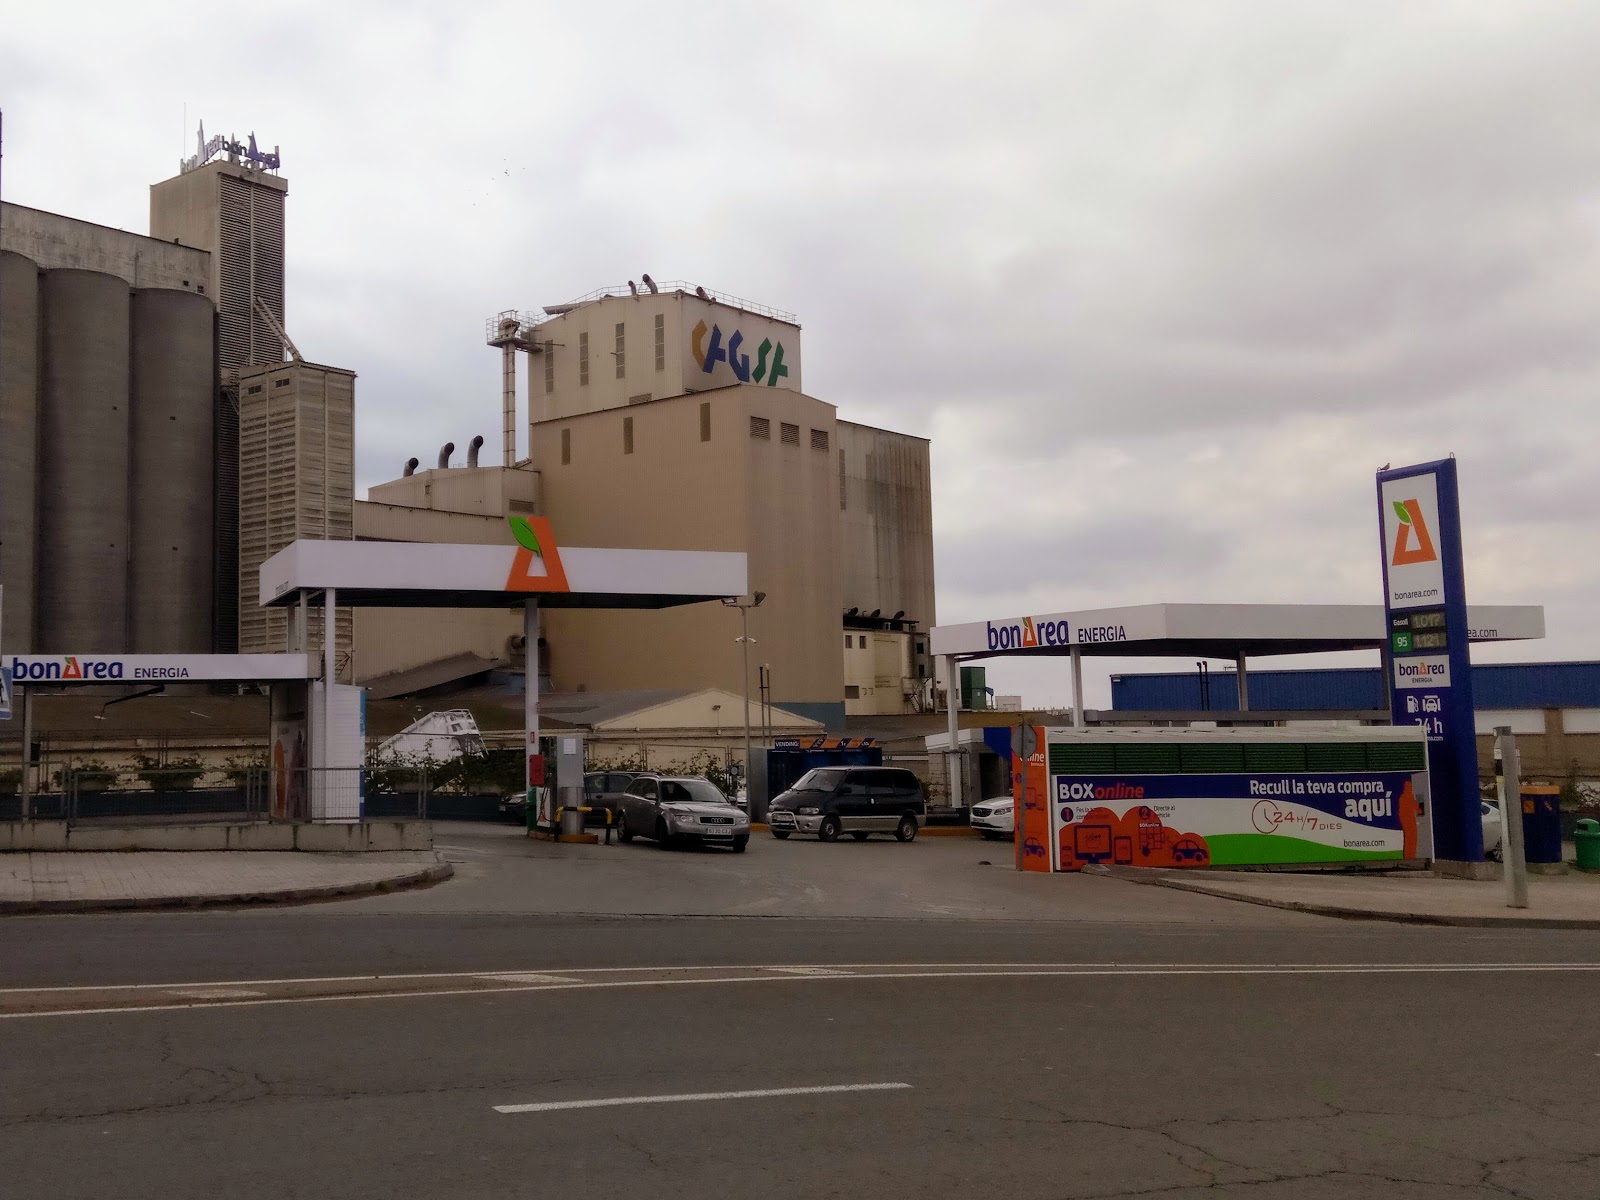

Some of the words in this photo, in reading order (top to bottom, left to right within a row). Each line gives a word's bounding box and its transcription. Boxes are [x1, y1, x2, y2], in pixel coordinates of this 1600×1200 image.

[692, 319, 788, 387] CAGSA
[1394, 589, 1438, 600] bonarea.com
[1078, 626, 1127, 643] ENERGIA
[1467, 629, 1498, 638] ea.com
[1397, 636, 1408, 647] 95
[134, 668, 189, 679] ENERGIA
[1434, 717, 1444, 734] h
[1250, 780, 1290, 795] Recull
[1292, 780, 1305, 794] la
[1307, 780, 1335, 794] teva
[1337, 781, 1384, 795] compra
[1345, 791, 1392, 821] aquí
[1344, 839, 1385, 848] bonarea.com
